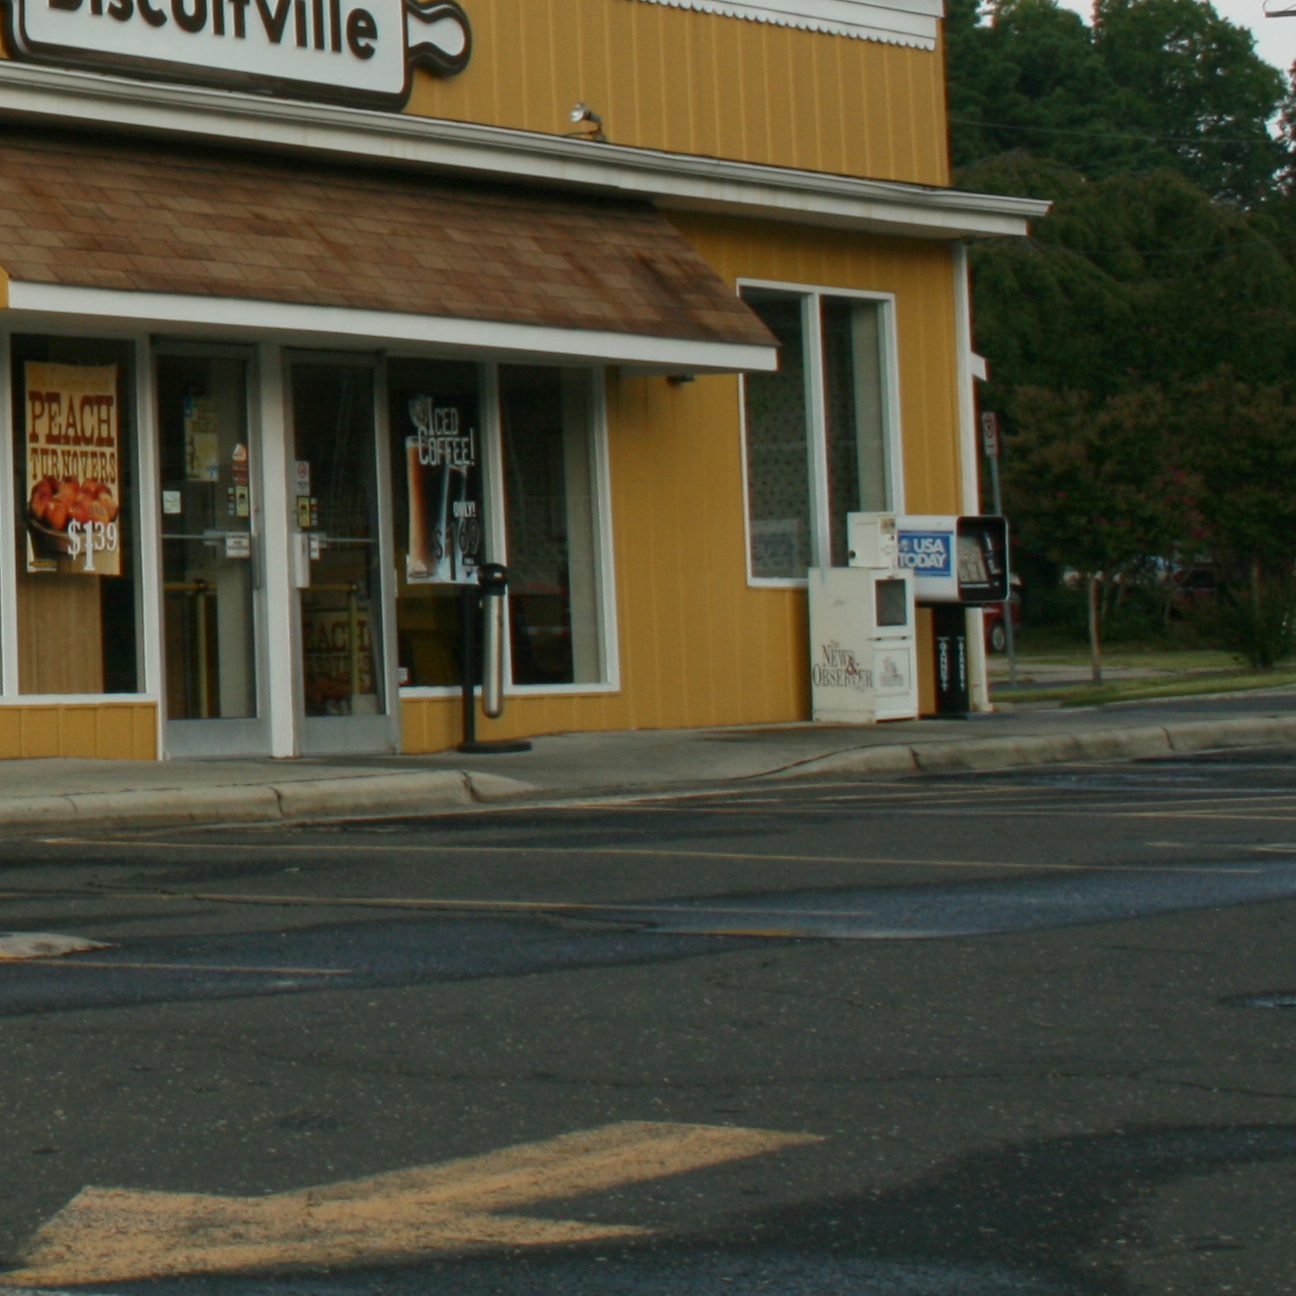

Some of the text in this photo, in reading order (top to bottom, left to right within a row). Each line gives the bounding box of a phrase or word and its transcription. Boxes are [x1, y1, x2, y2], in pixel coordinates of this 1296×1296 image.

[29, 390, 114, 447] PEACH
[30, 447, 117, 484] TURNOVERS
[913, 538, 945, 554] USA
[898, 554, 946, 569] TODAY
[812, 664, 873, 688] OBSERVER
